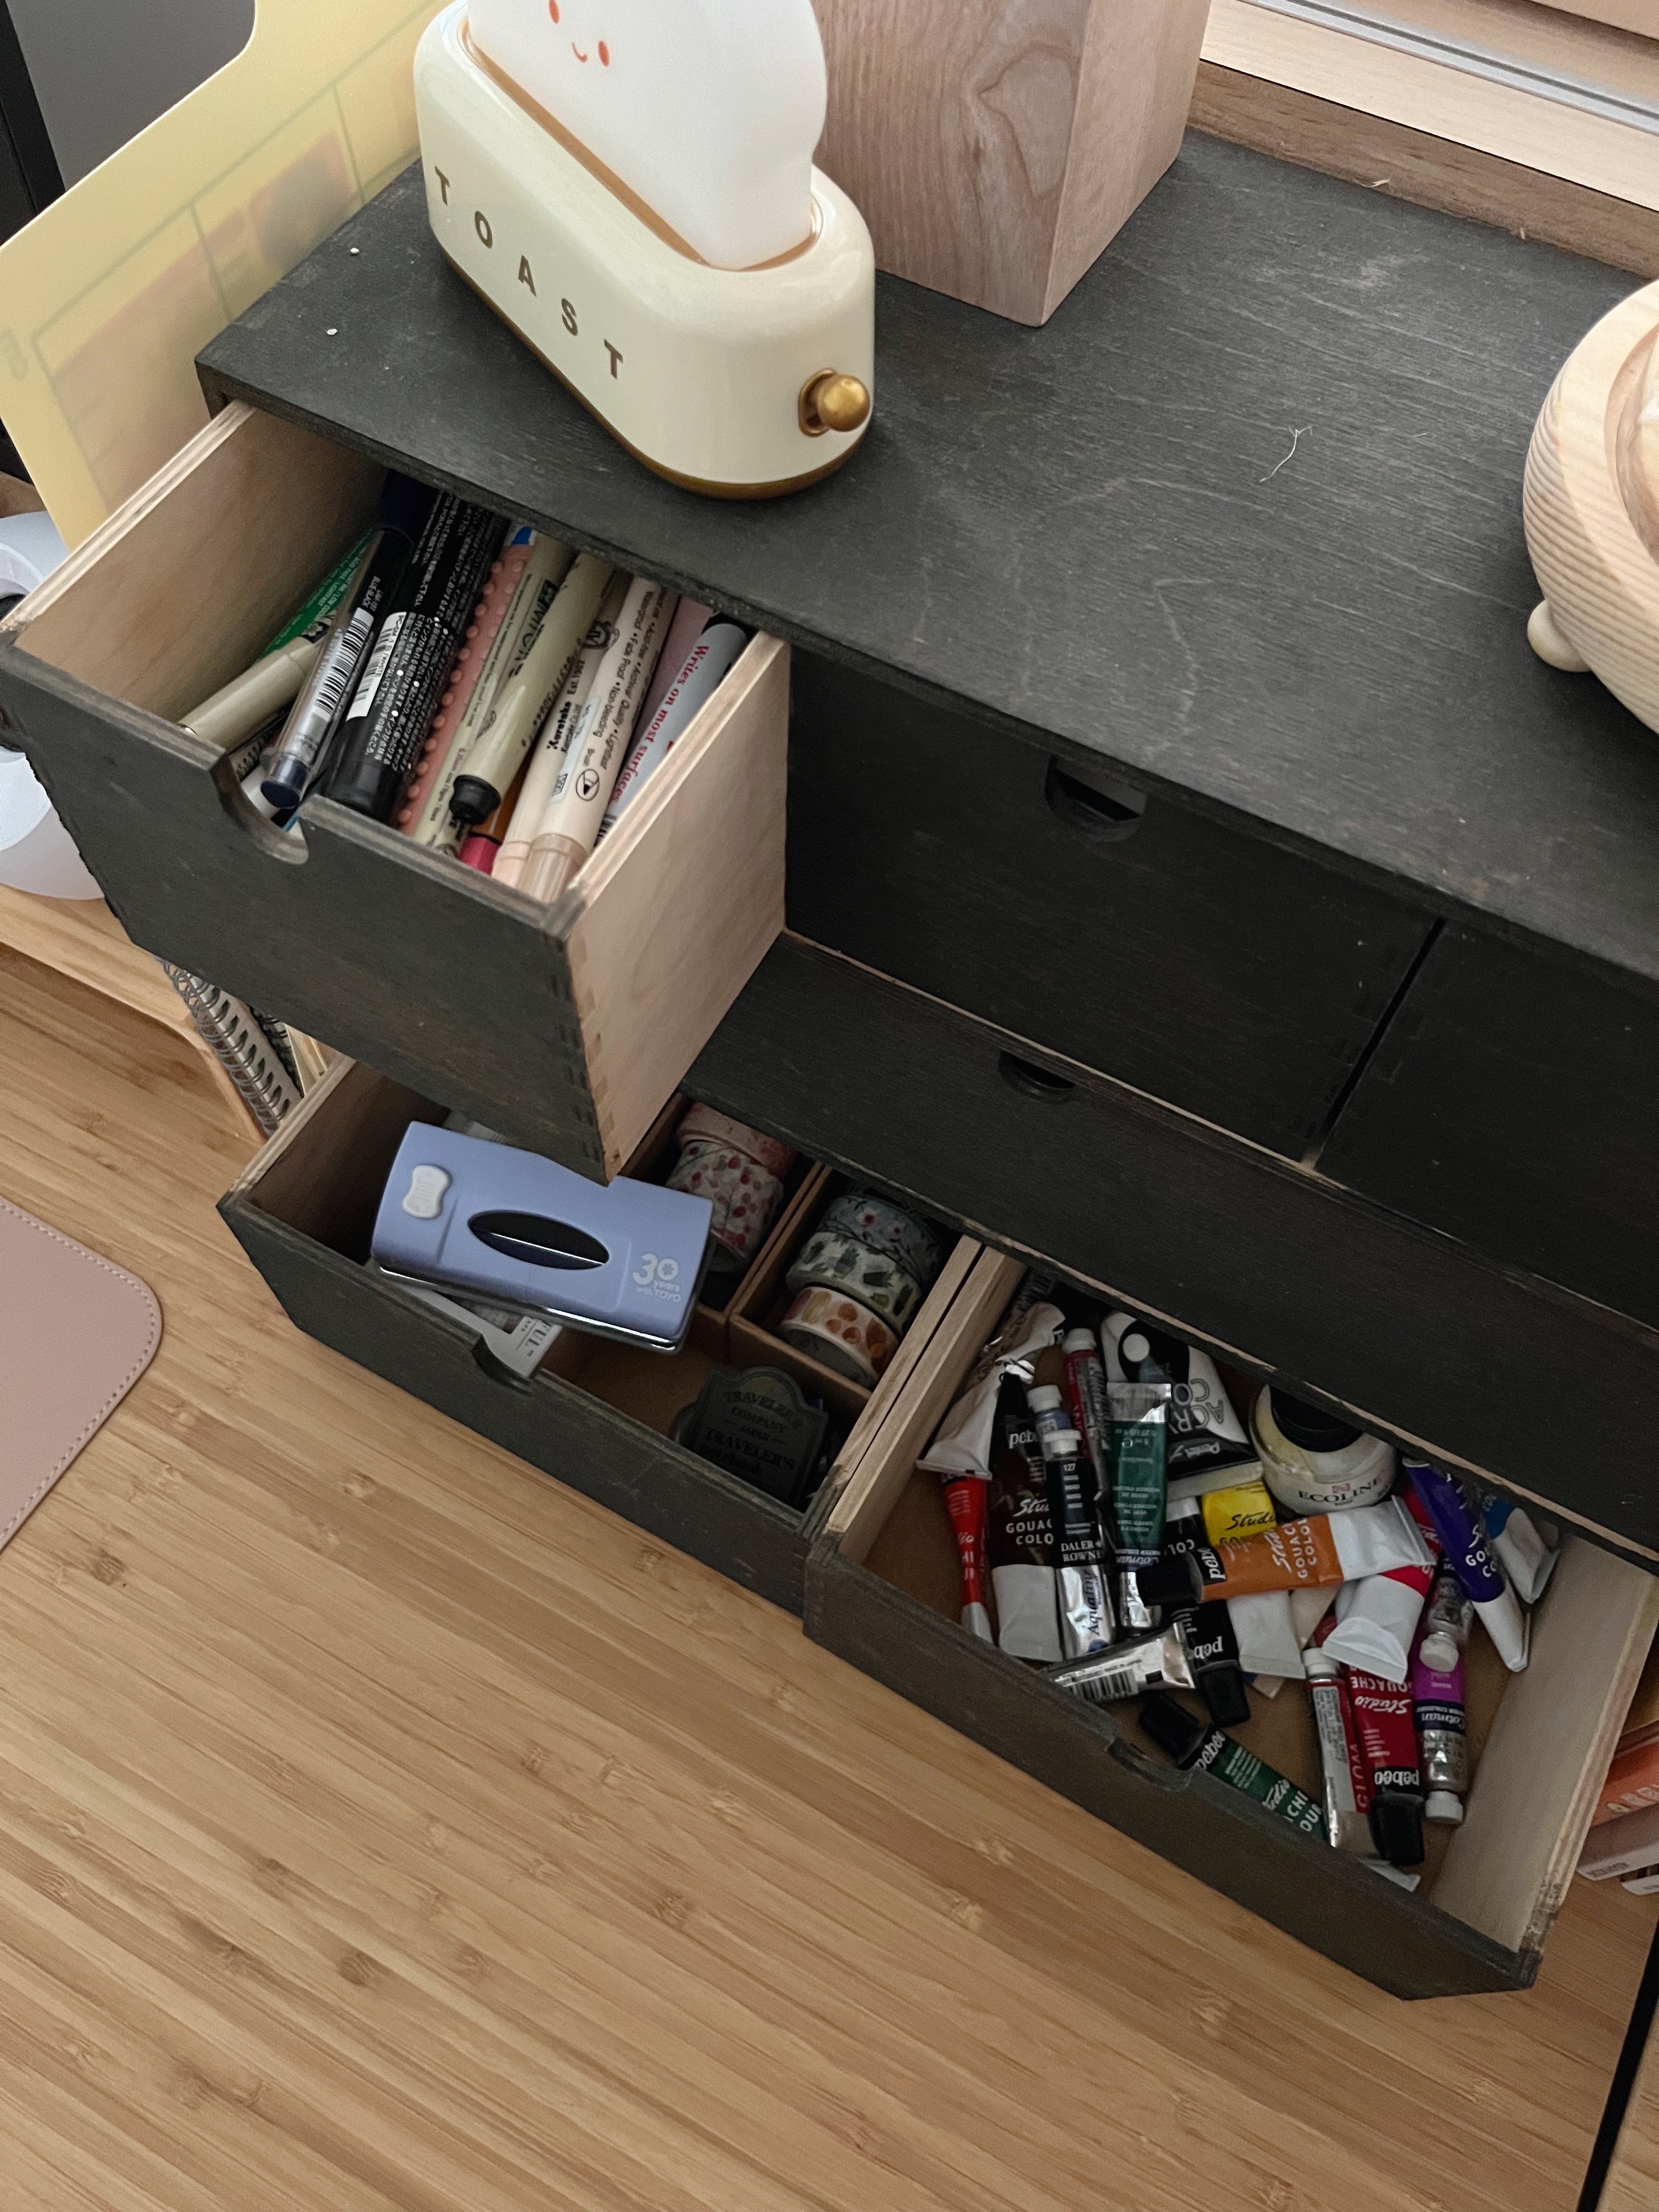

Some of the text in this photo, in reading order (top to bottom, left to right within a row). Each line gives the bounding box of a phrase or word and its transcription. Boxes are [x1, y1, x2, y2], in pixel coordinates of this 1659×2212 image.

[435, 166, 623, 379] TOAST
[624, 636, 638, 656] Fade
[617, 658, 631, 679] Proof
[677, 645, 710, 686] Writes
[665, 688, 679, 706] on
[645, 709, 668, 743] most
[610, 745, 648, 804] surfaces
[633, 1253, 679, 1285] 30
[731, 1406, 787, 1434] COMPANY
[1013, 1498, 1050, 1517] Stu
[1015, 1532, 1054, 1545] COLO
[1060, 1540, 1094, 1552] DALER
[1193, 1635, 1223, 1659] peb
[1354, 1695, 1413, 1715] Studio
[1374, 1769, 1420, 1786] pebeo
